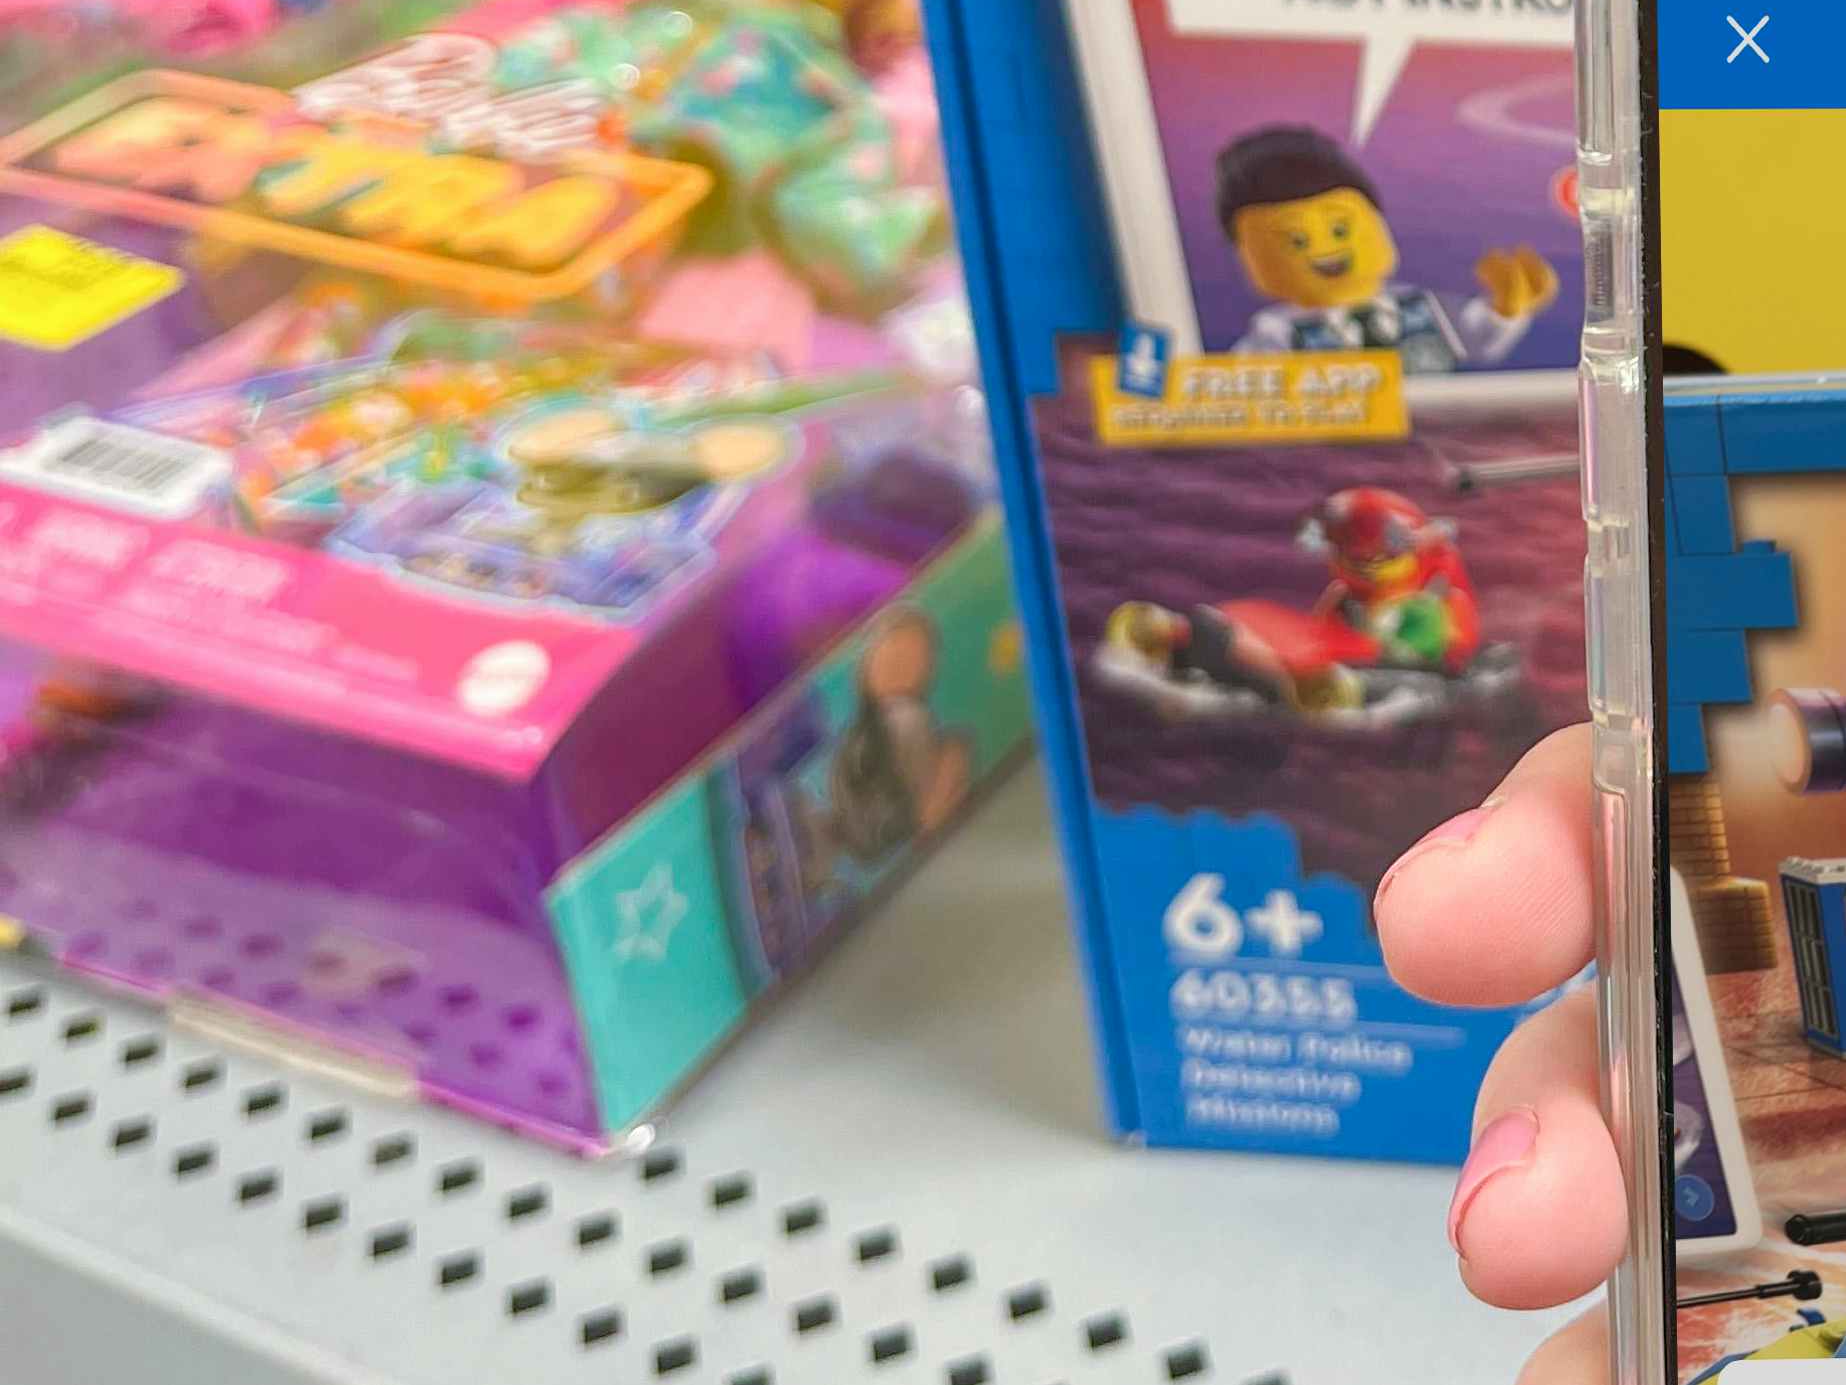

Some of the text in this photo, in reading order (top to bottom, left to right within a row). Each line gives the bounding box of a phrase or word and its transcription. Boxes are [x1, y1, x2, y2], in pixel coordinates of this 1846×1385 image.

[1180, 360, 1384, 402] FREE APP
[1163, 872, 1324, 961] 6+
